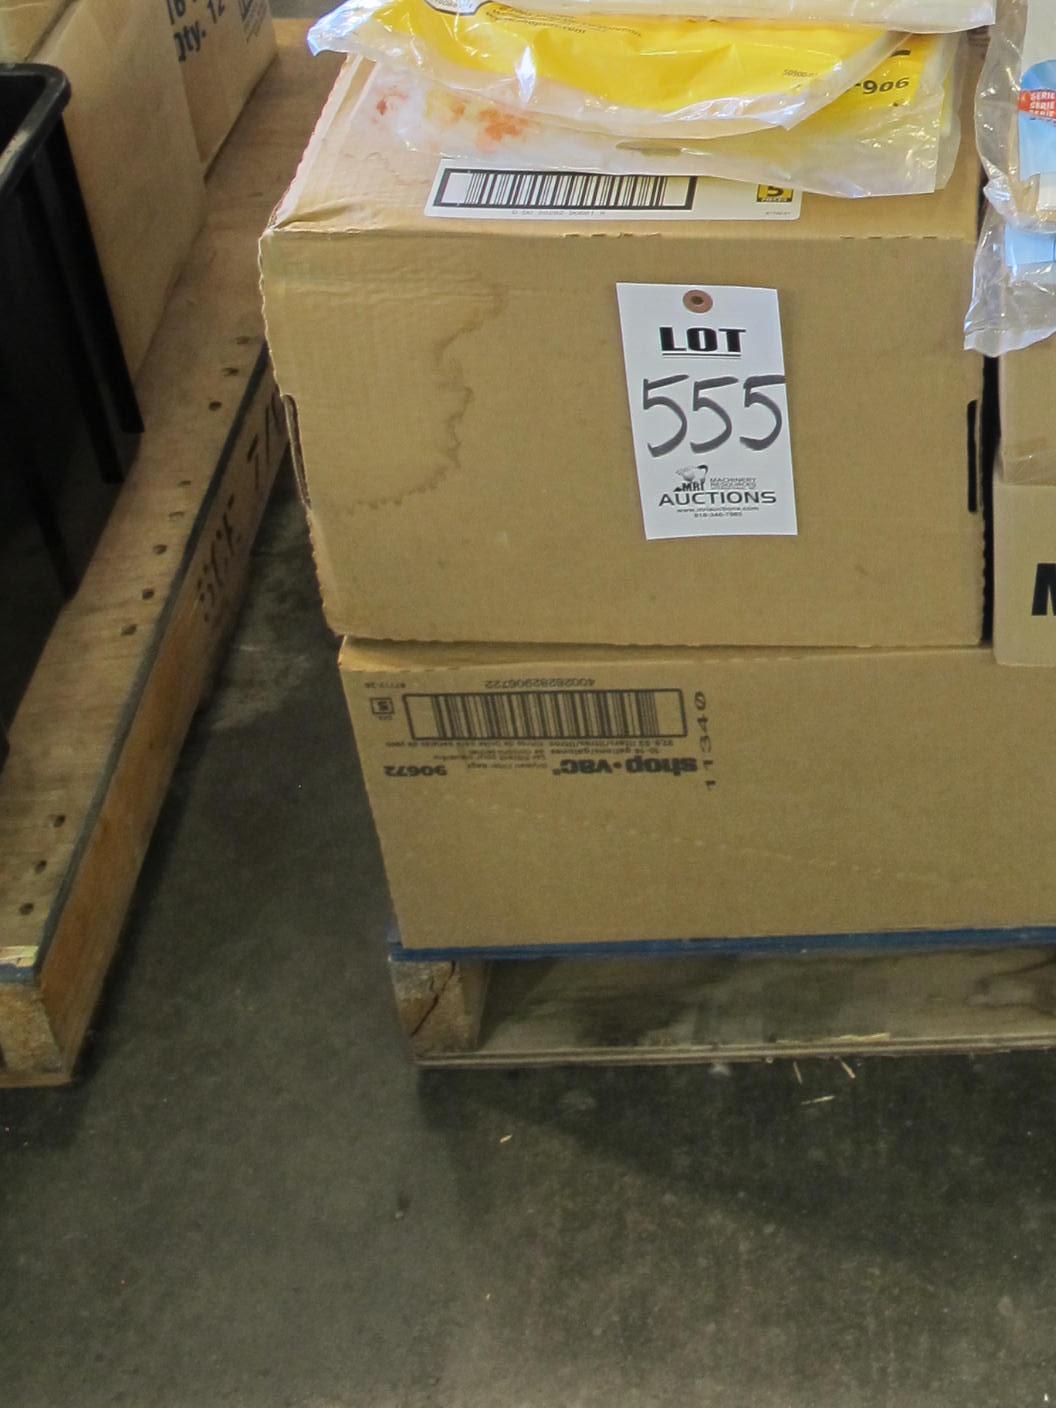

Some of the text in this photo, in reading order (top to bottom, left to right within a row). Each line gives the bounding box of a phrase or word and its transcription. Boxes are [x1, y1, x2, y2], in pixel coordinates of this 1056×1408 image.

[659, 326, 746, 353] LOT
[642, 373, 787, 458] 555
[658, 491, 777, 507] AUCTIONS
[384, 764, 448, 777] 90672
